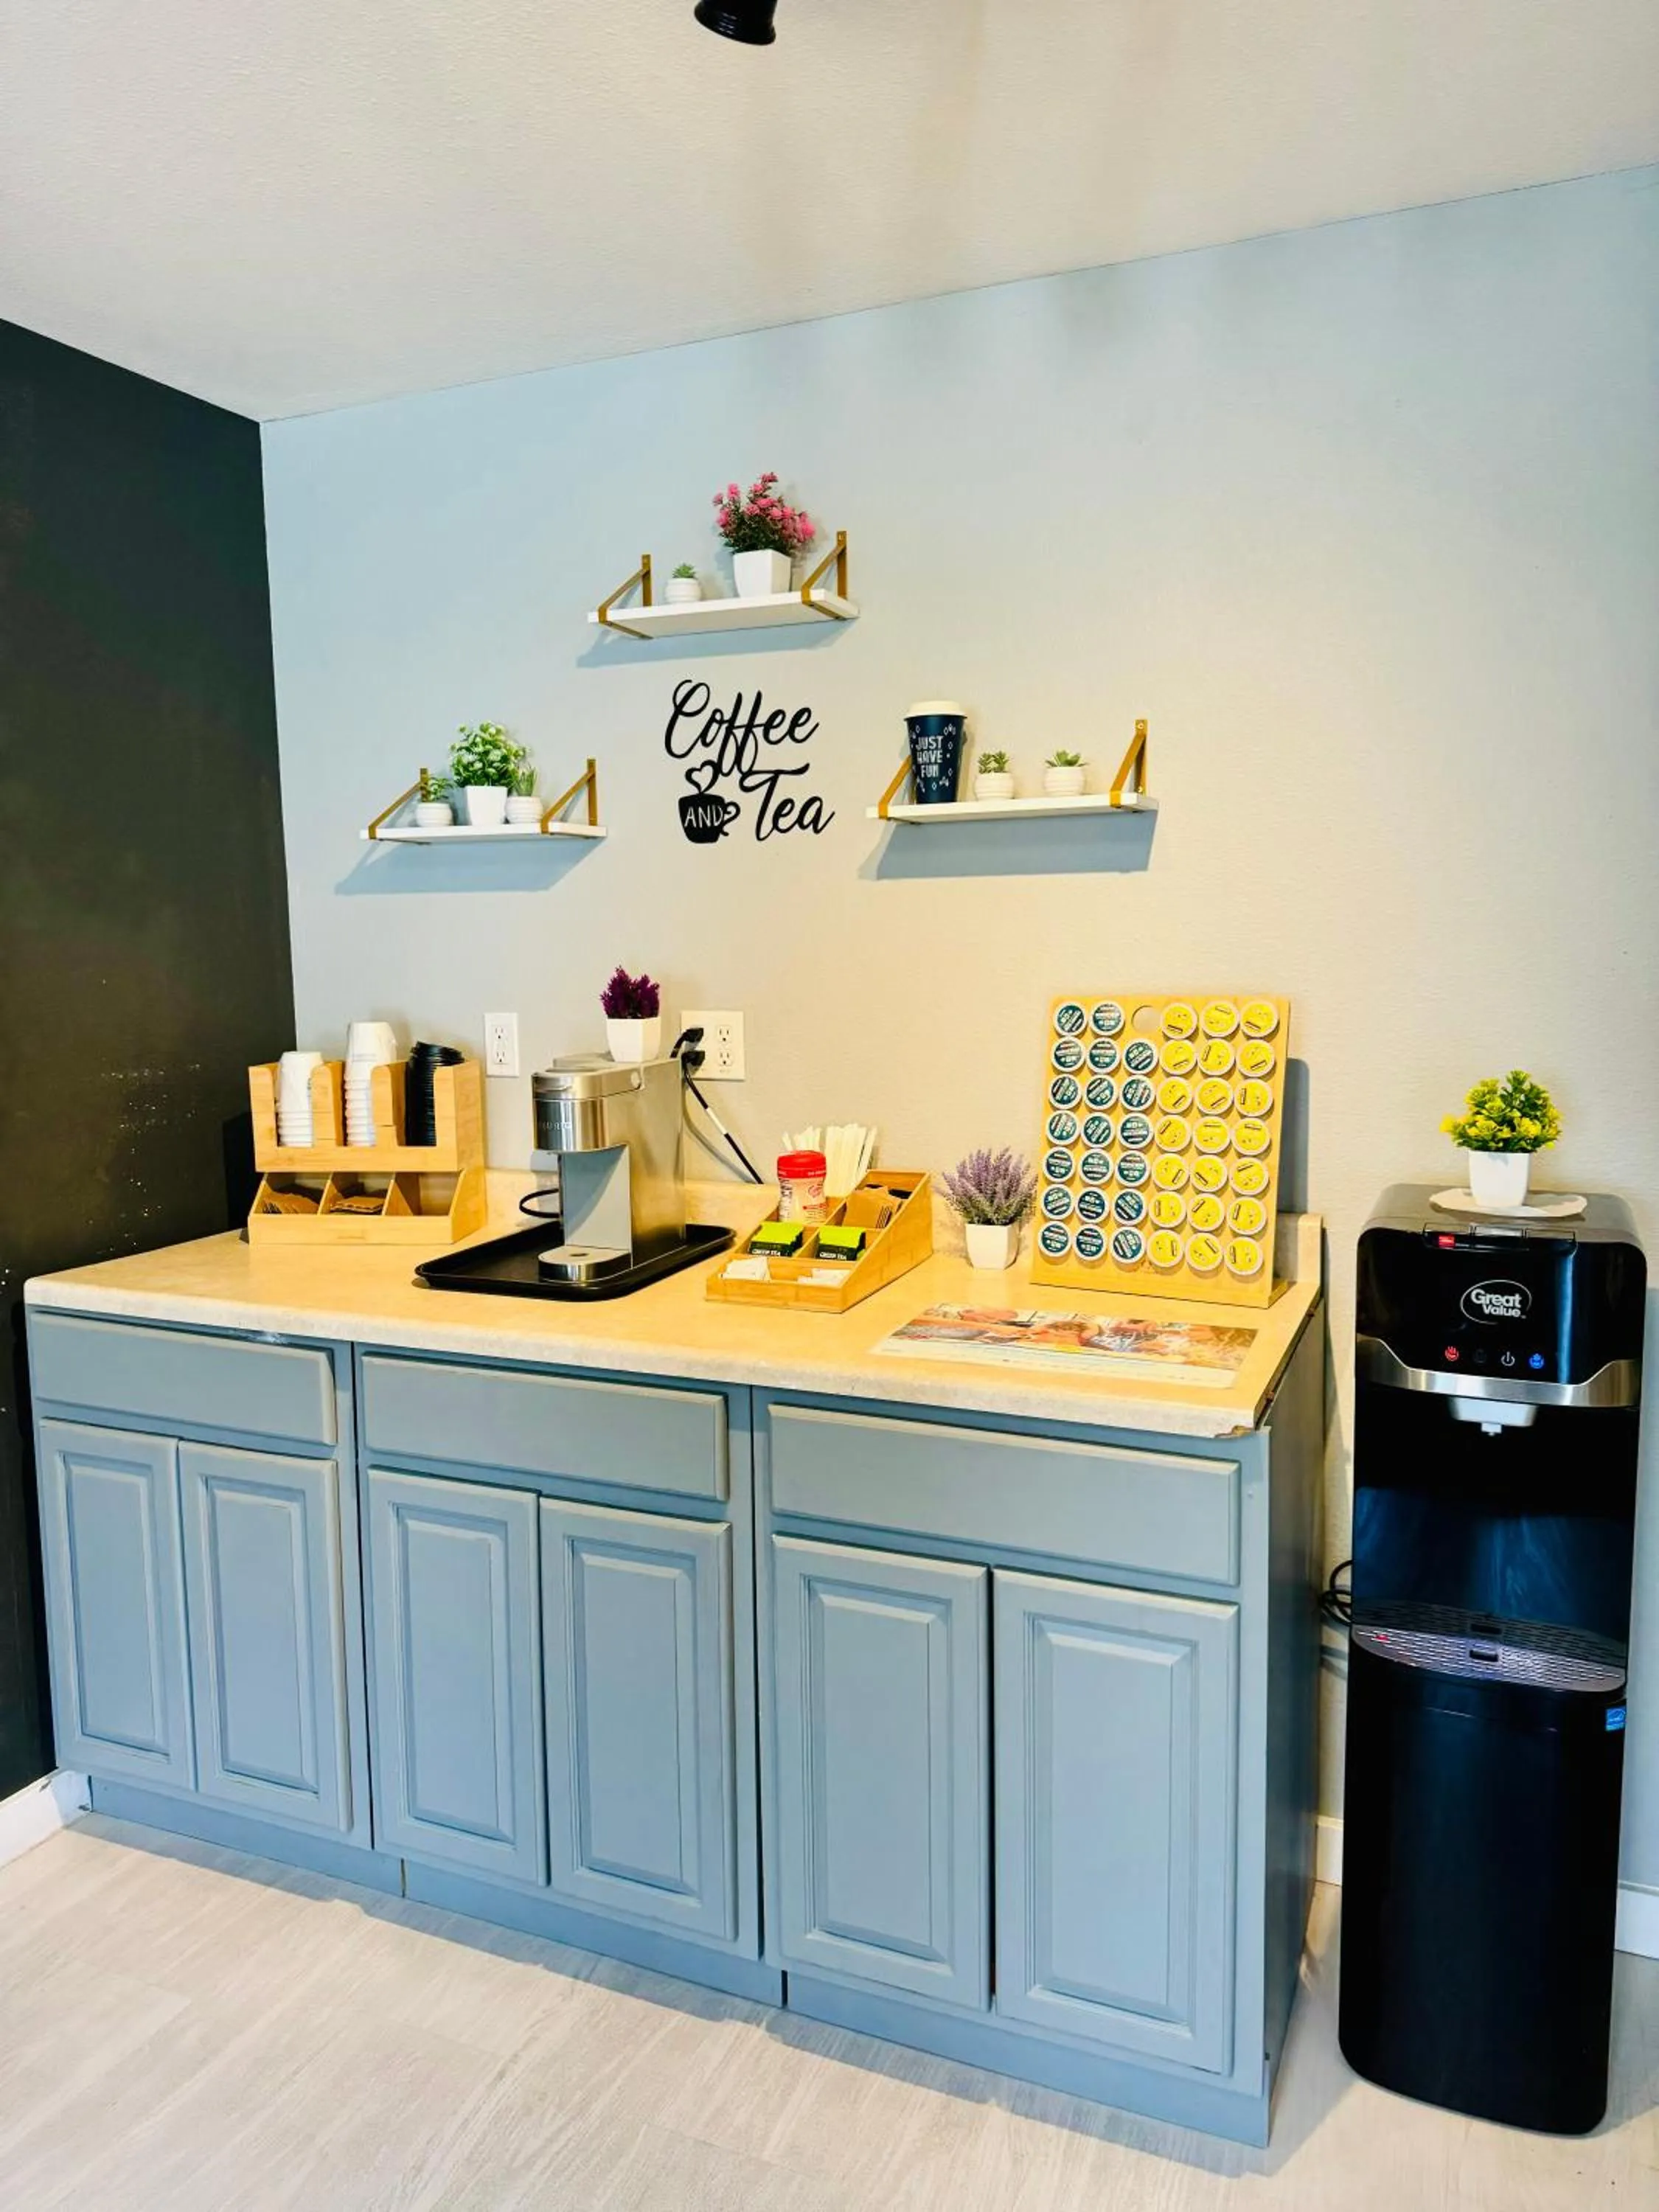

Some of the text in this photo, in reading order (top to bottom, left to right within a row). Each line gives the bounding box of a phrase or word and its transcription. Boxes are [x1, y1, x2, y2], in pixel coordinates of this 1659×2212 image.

[664, 679, 819, 777] Coffee
[916, 736, 944, 750] JUST
[917, 750, 943, 763] HAVE
[920, 765, 939, 778] FUN
[739, 762, 835, 841] Tea
[684, 805, 724, 828] AND
[1471, 1288, 1522, 1308] Great
[1482, 1304, 1521, 1318] Value
